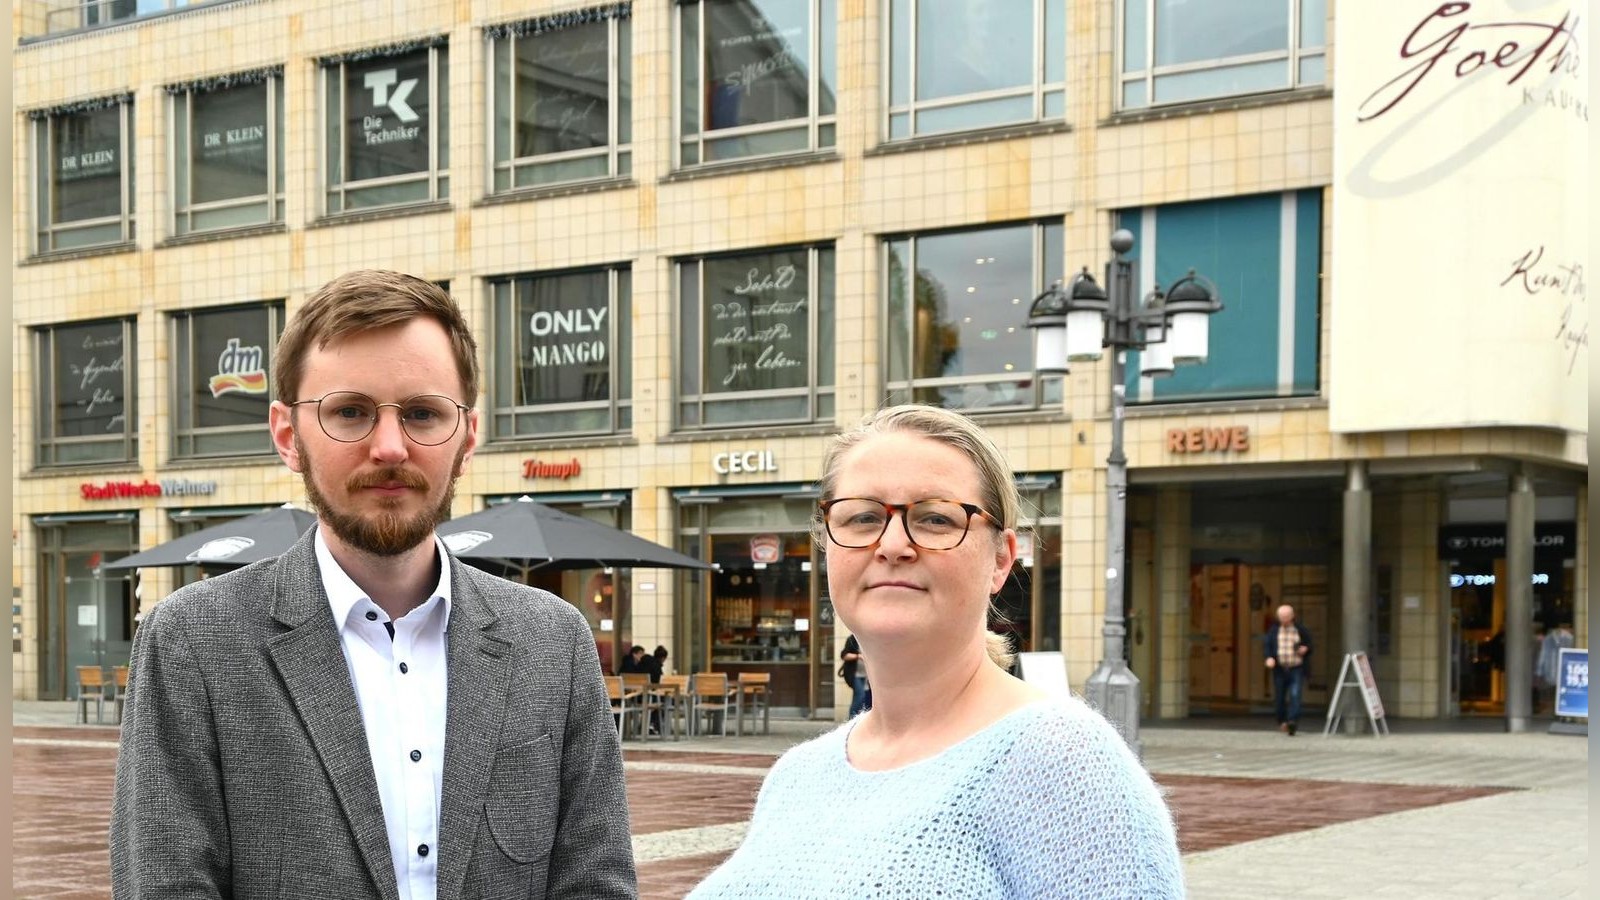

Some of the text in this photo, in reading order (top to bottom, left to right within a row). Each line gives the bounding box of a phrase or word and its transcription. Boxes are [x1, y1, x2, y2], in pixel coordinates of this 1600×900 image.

[364, 68, 419, 123] TK
[363, 115, 382, 129] Die
[226, 125, 264, 144] KLEIN
[364, 125, 419, 145] Techniker
[81, 150, 114, 166] KLEIN
[530, 306, 607, 336] ONLY
[219, 338, 262, 375] dm
[532, 341, 605, 367] MANGO
[1168, 425, 1249, 454] REWE
[522, 458, 581, 480] Triumph
[713, 451, 778, 476] CECIL
[1471, 536, 1505, 547] TOM
[1465, 574, 1496, 586] TOM
